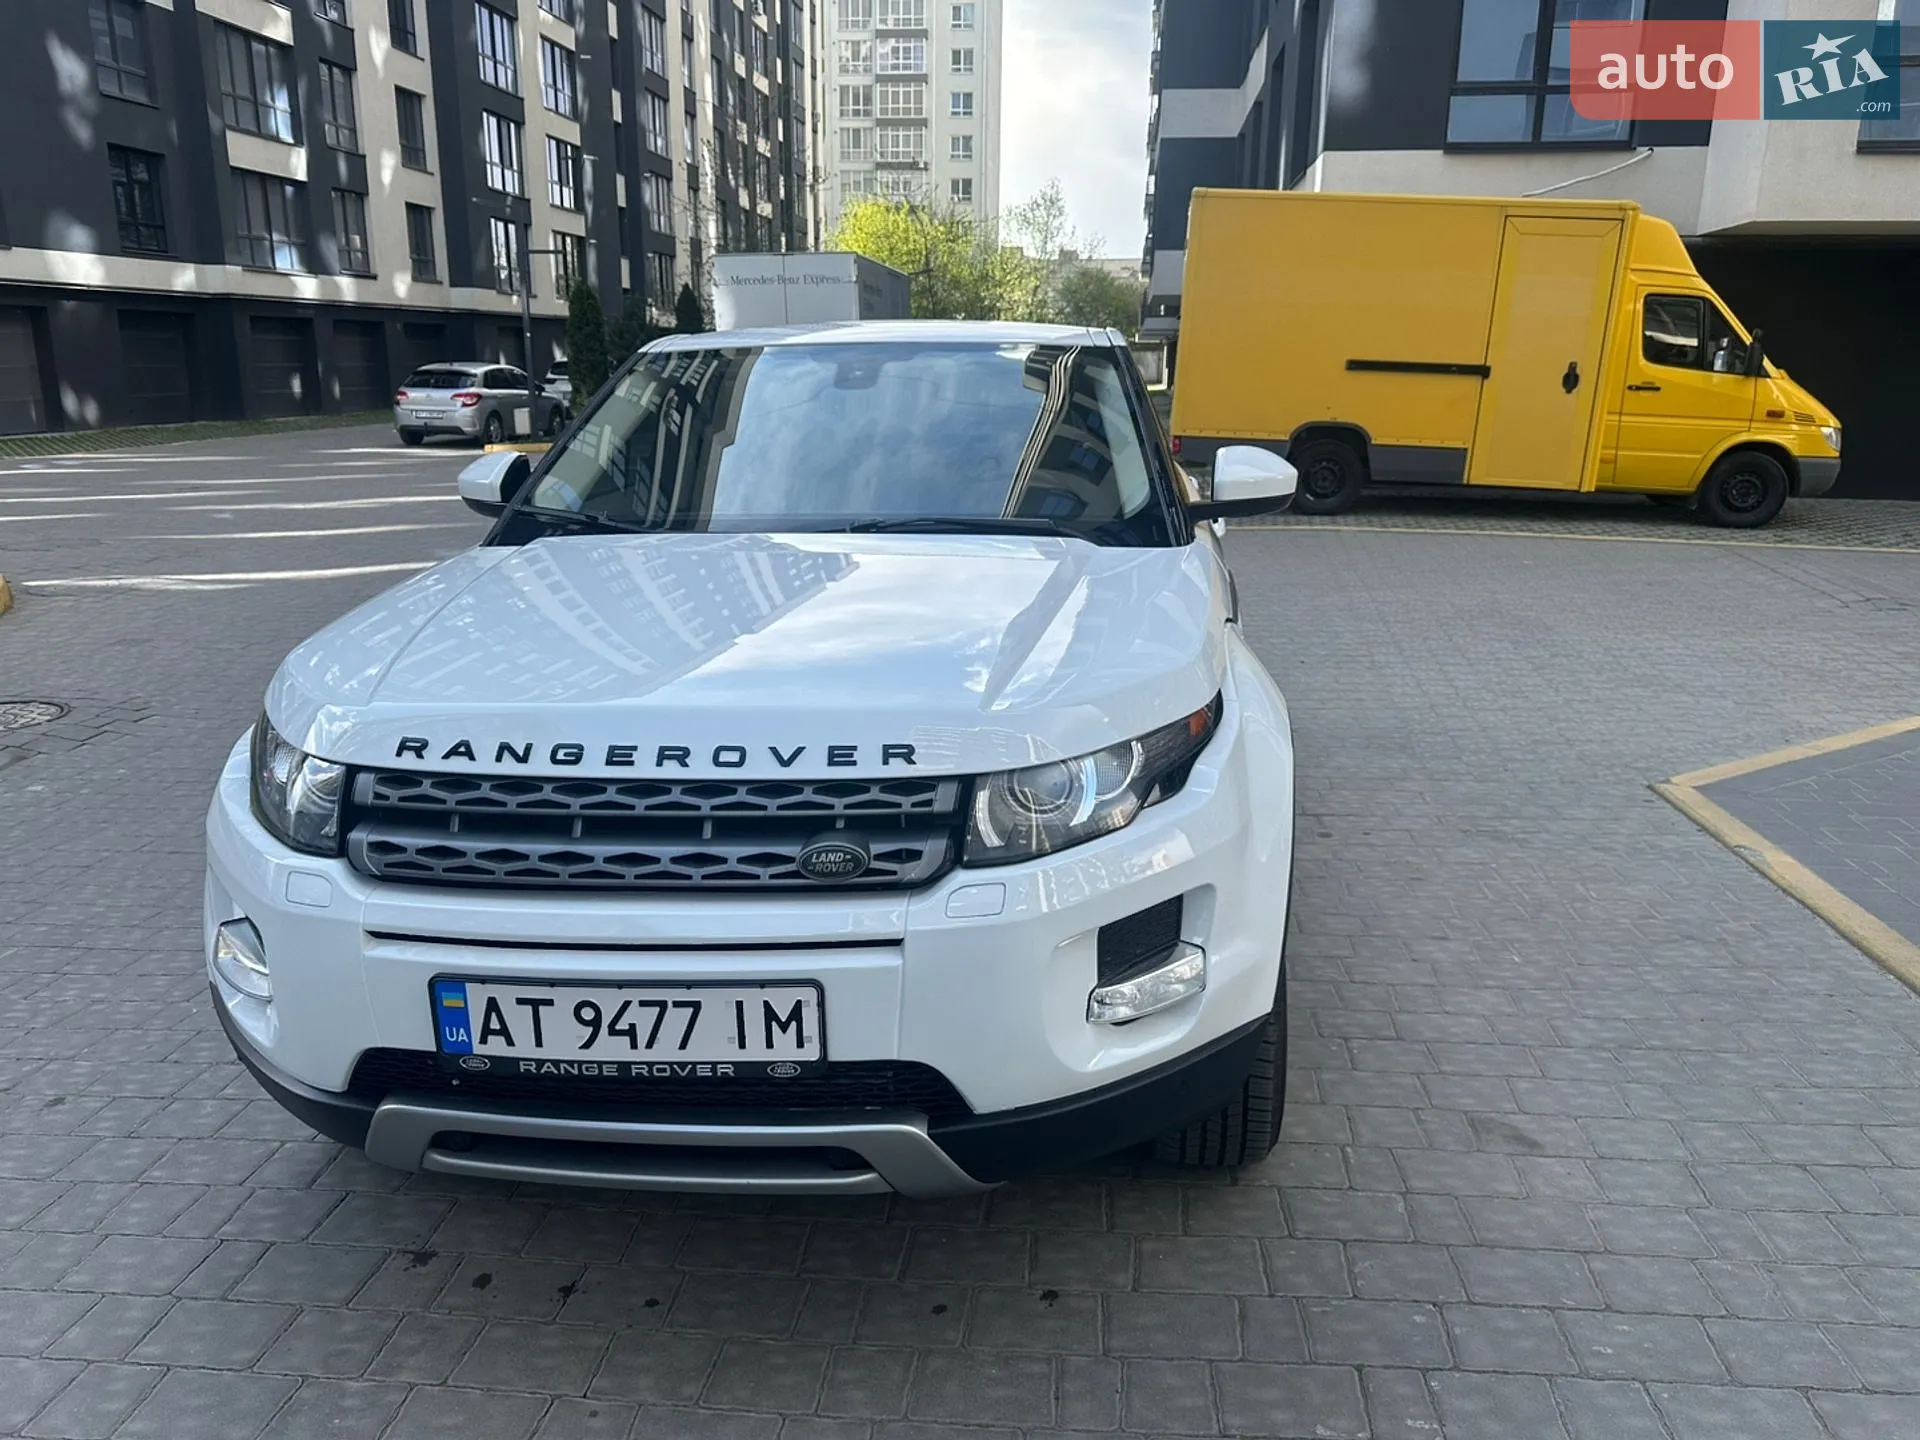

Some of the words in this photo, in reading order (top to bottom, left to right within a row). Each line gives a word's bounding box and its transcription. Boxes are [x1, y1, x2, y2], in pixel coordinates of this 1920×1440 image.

[803, 273, 841, 287] Express
[478, 996, 555, 1048] AT
[573, 999, 703, 1050] 9477
[734, 999, 805, 1050] IM
[445, 1026, 469, 1043] UA
[519, 1060, 619, 1077] RANGE
[631, 1063, 736, 1078] ROVER
